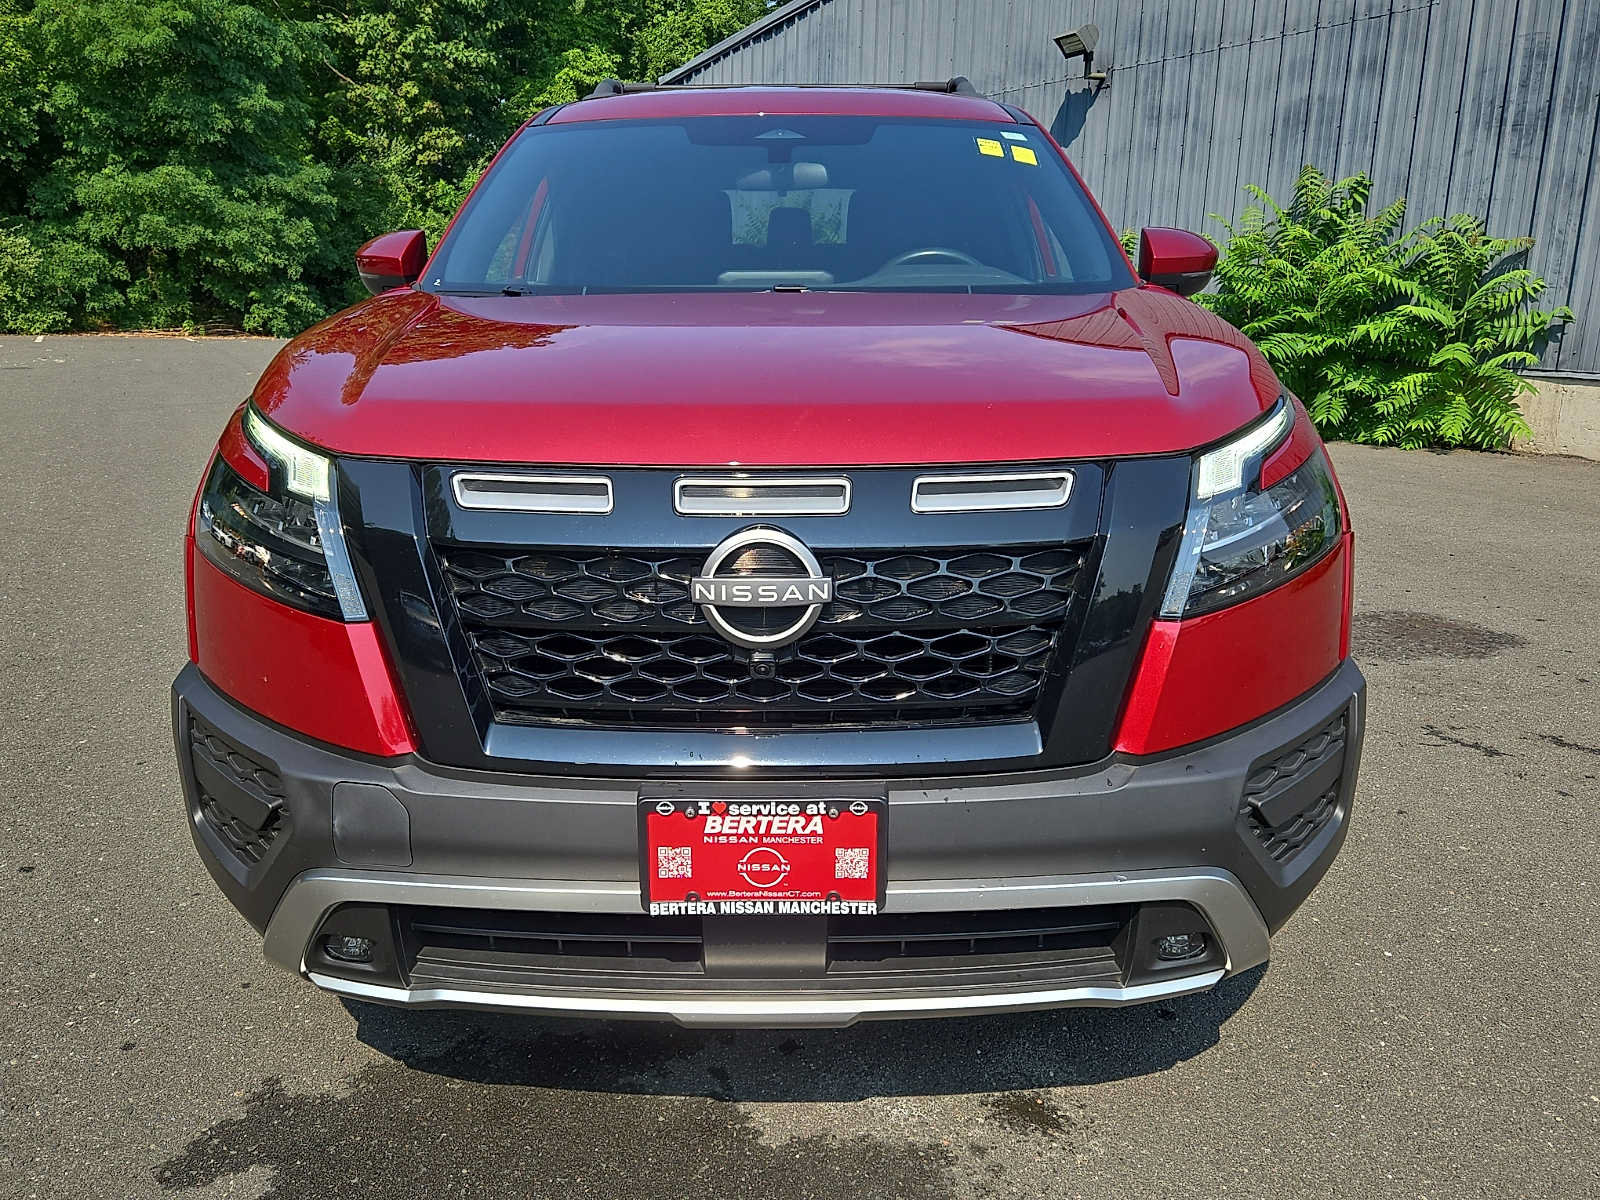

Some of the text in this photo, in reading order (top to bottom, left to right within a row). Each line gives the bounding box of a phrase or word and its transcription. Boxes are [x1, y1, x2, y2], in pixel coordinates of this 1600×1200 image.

[695, 583, 829, 602] NISSAN
[698, 801, 827, 816] I service at
[703, 816, 824, 834] BERTERA
[703, 836, 824, 844] NISSAN MANCHESTER
[737, 863, 791, 872] NISSAN
[706, 890, 821, 898] www.BerteraNissanCT.com
[650, 901, 878, 916] BERTERA NISSAN MANCHESTER
